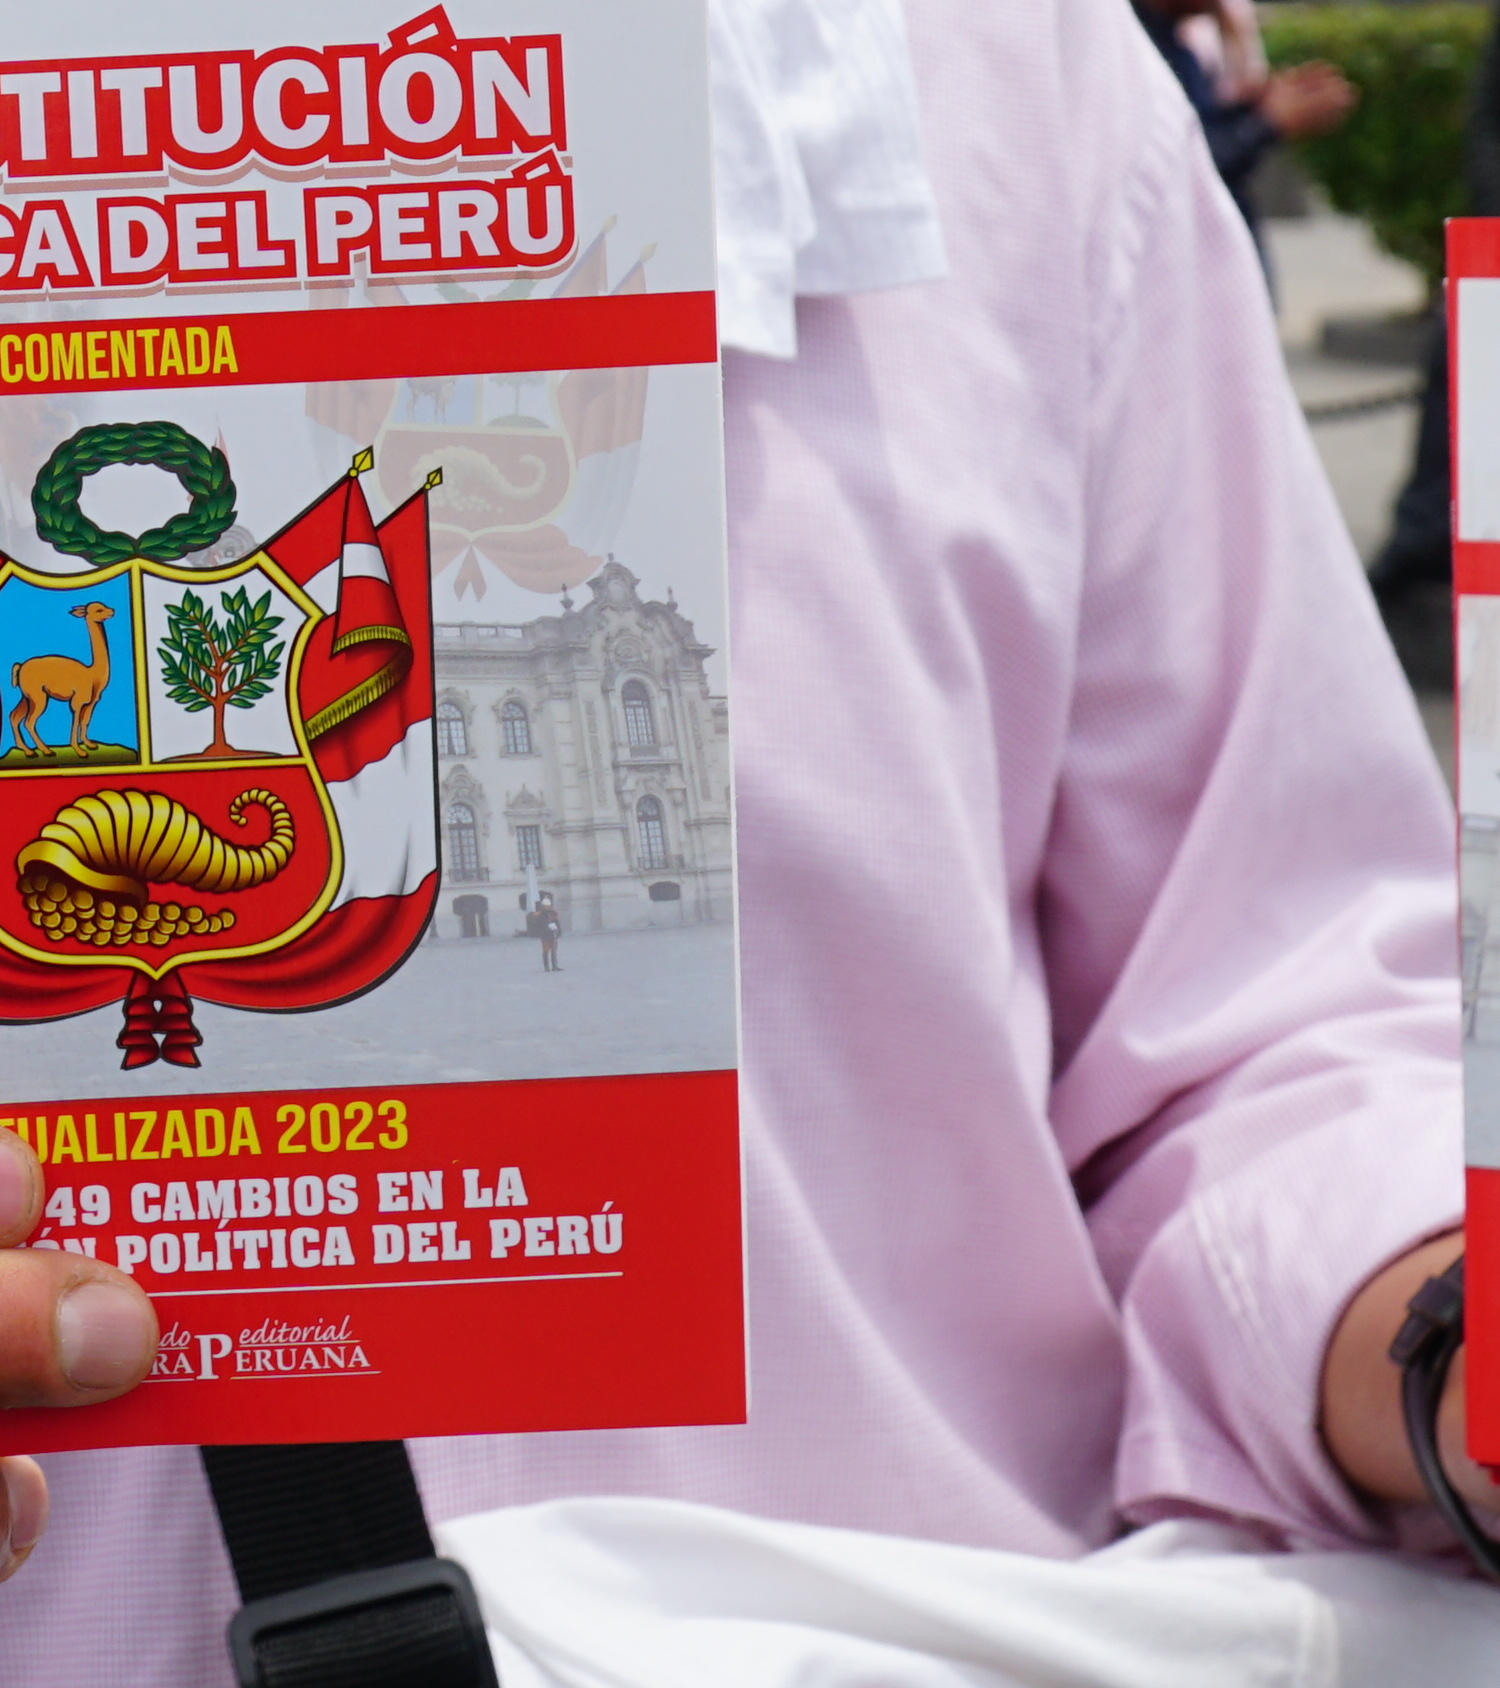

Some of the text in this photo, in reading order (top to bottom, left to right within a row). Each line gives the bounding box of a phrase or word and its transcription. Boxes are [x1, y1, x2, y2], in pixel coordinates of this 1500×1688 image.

[102, 196, 291, 280] DEL
[309, 156, 570, 271] PERÚ
[0, 326, 238, 383] COMENTADA
[276, 1099, 410, 1155] 2023
[44, 1165, 529, 1228] 49 CAMBIOS EN LA
[115, 1218, 356, 1275] POLÍTICA
[371, 1220, 472, 1265] DEL
[488, 1200, 624, 1259] PERÚ
[194, 1332, 371, 1380] PERUANA
[238, 1314, 353, 1346] editorial
